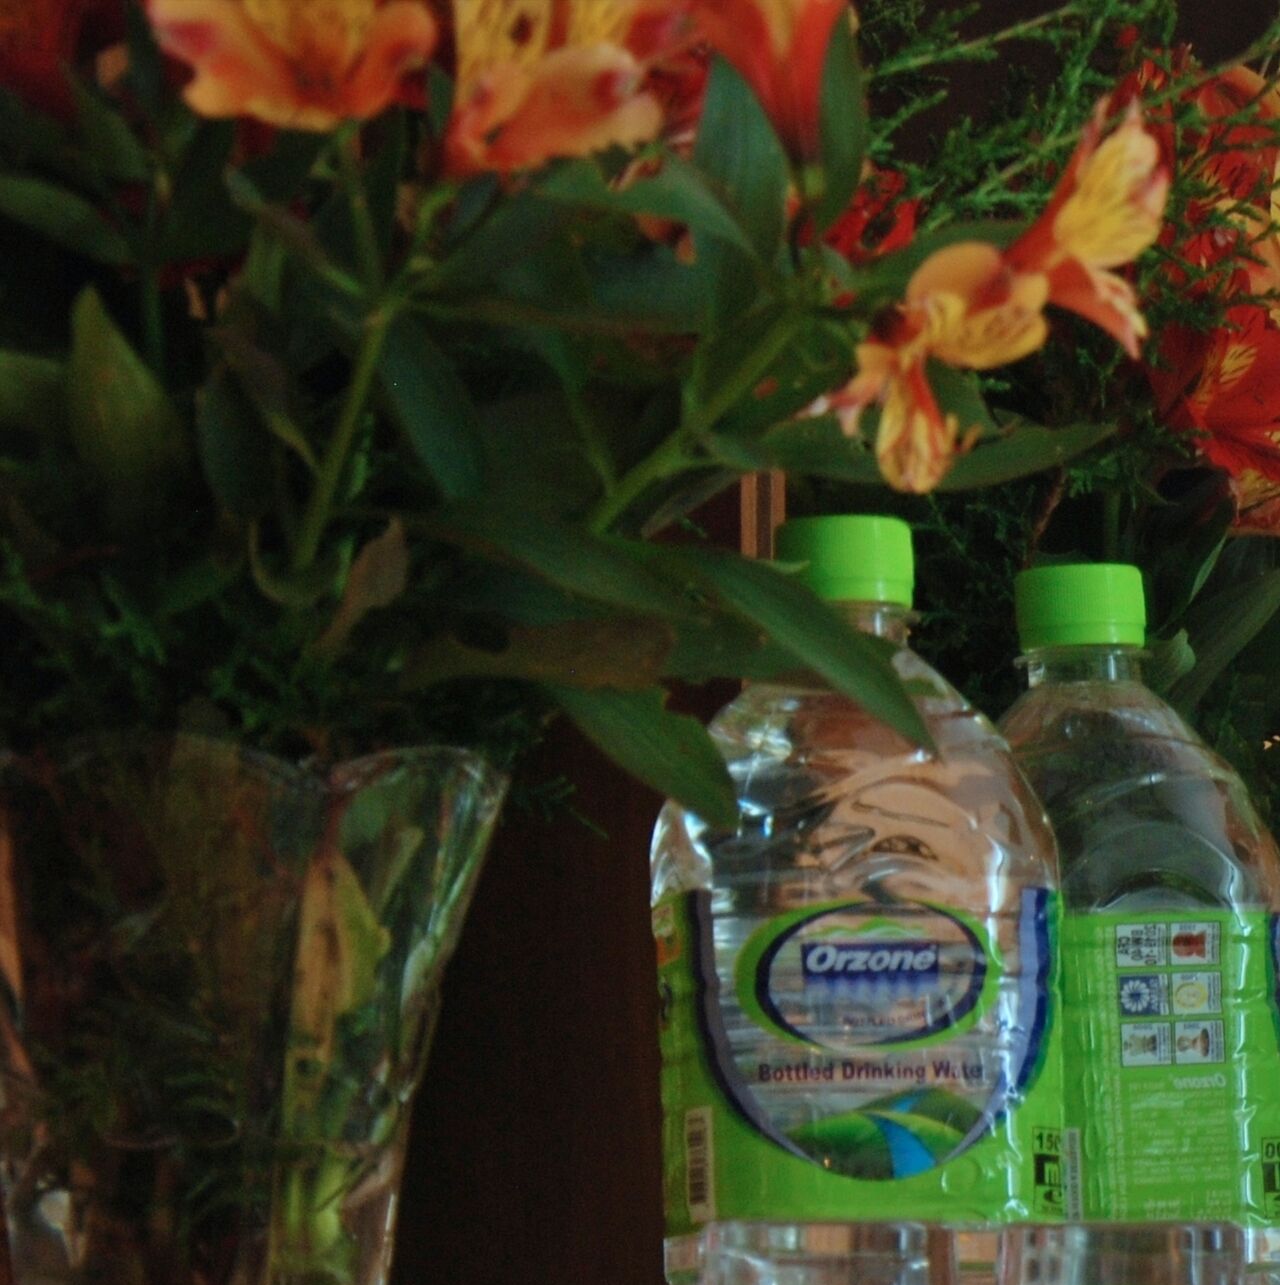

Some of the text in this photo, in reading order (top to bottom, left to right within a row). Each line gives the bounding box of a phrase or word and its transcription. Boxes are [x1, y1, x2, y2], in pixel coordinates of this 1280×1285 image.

[806, 945, 936, 972] Orzone
[758, 1062, 834, 1081] Bottled
[841, 1061, 926, 1086] Drinking
